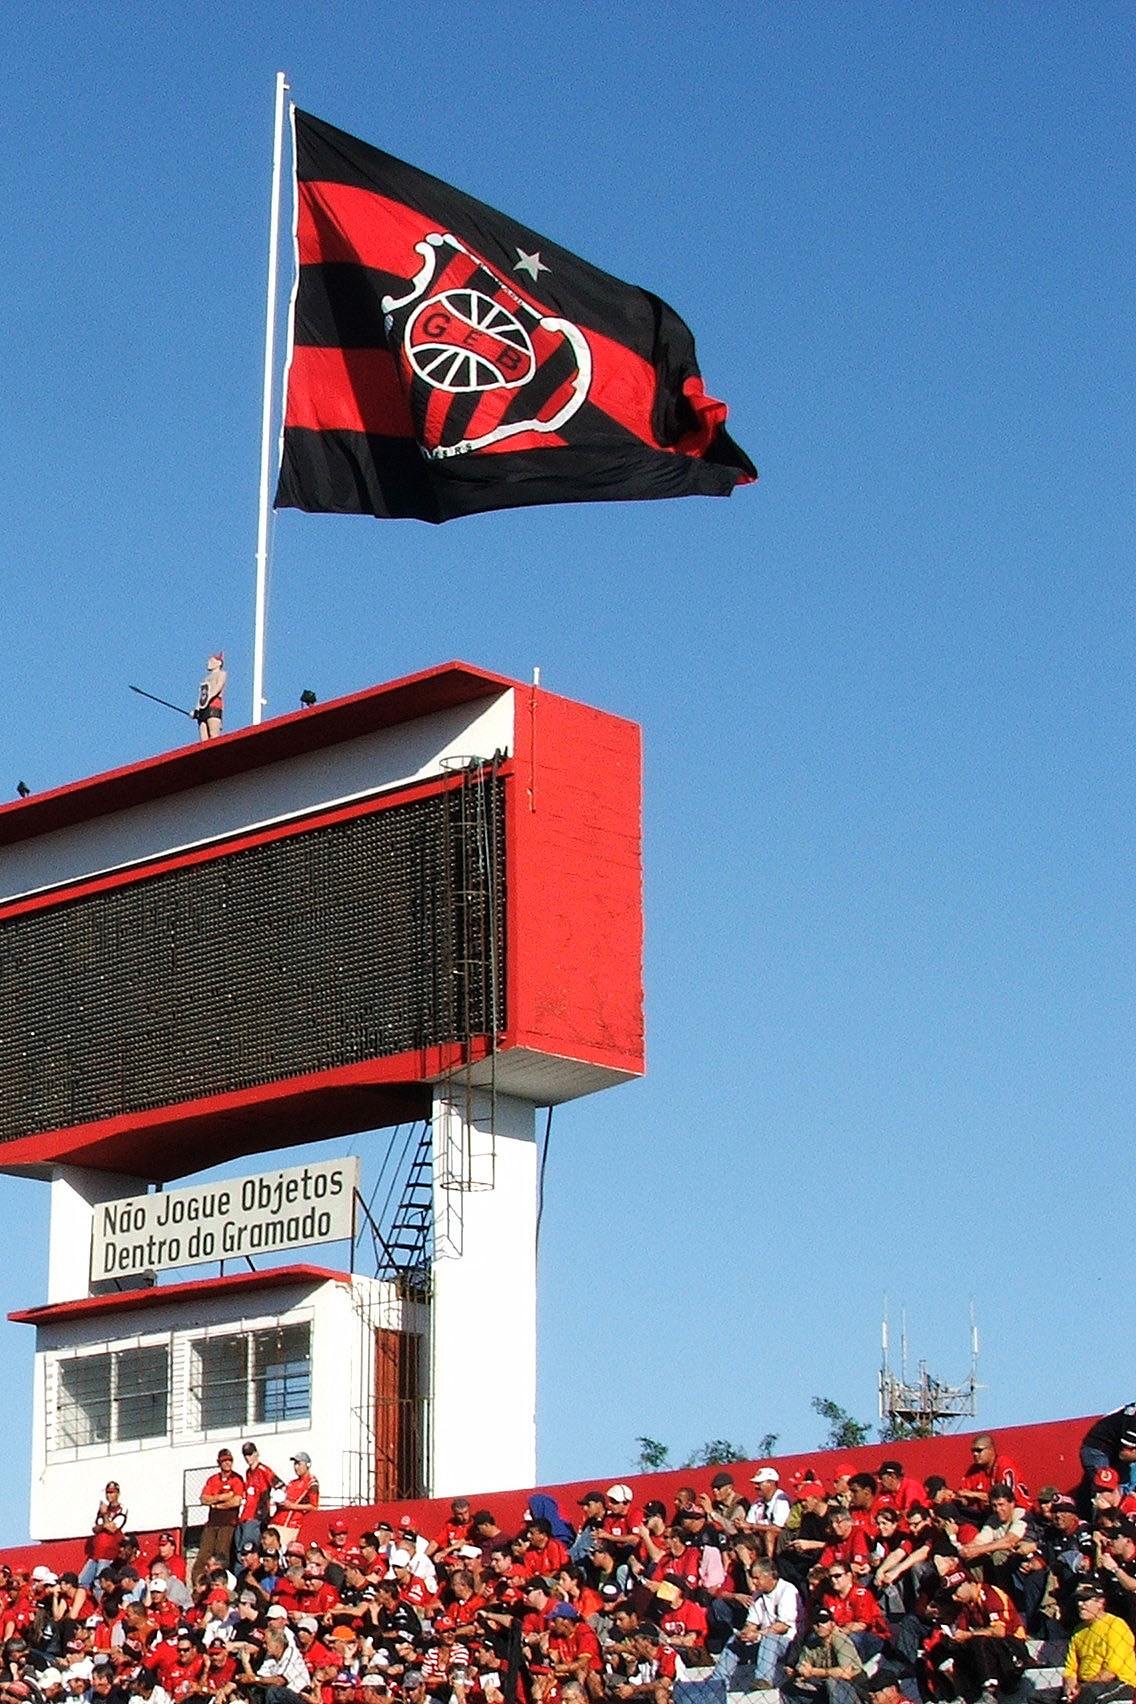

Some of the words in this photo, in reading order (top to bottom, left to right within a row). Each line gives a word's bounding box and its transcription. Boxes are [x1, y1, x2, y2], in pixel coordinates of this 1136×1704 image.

[103, 1202, 146, 1237] Não
[241, 1168, 343, 1215] Objetos
[103, 1234, 181, 1273] Dentro
[188, 1227, 215, 1259] do
[222, 1206, 331, 1253] Gramado
